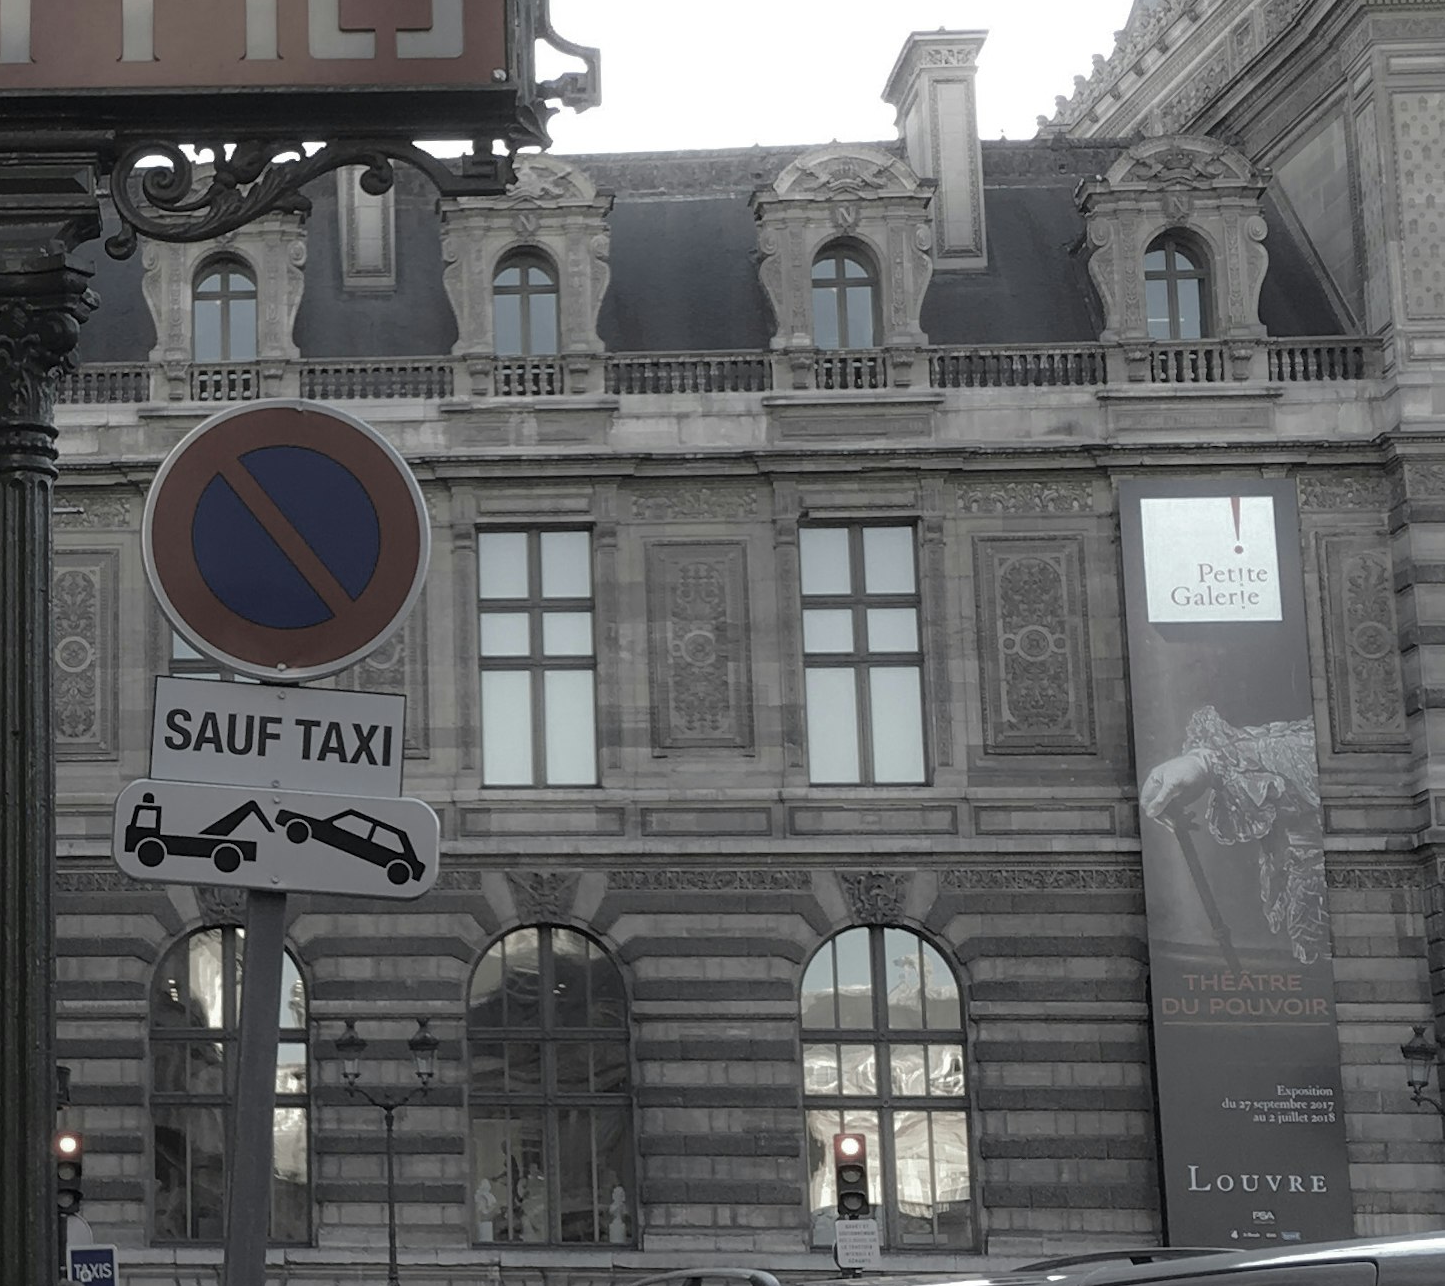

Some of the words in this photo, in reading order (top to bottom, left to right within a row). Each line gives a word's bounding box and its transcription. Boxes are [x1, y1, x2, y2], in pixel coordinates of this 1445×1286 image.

[164, 708, 283, 757] SAUF
[295, 719, 393, 768] TAXI
[1182, 970, 1303, 992] THÉÂTRE
[1161, 997, 1200, 1016] DU
[1209, 997, 1330, 1016] POUVOIR
[1276, 1084, 1334, 1098] Exposition
[1221, 1097, 1237, 1110] du
[1238, 1100, 1252, 1112] 27
[1253, 1099, 1308, 1112] septembre
[1309, 1100, 1335, 1111] 2017
[1253, 1115, 1267, 1123] au
[1268, 1114, 1276, 1123] 2
[1277, 1112, 1309, 1125] juillet
[1311, 1113, 1336, 1123] 2018
[1187, 1165, 1328, 1193] LOUVRE
